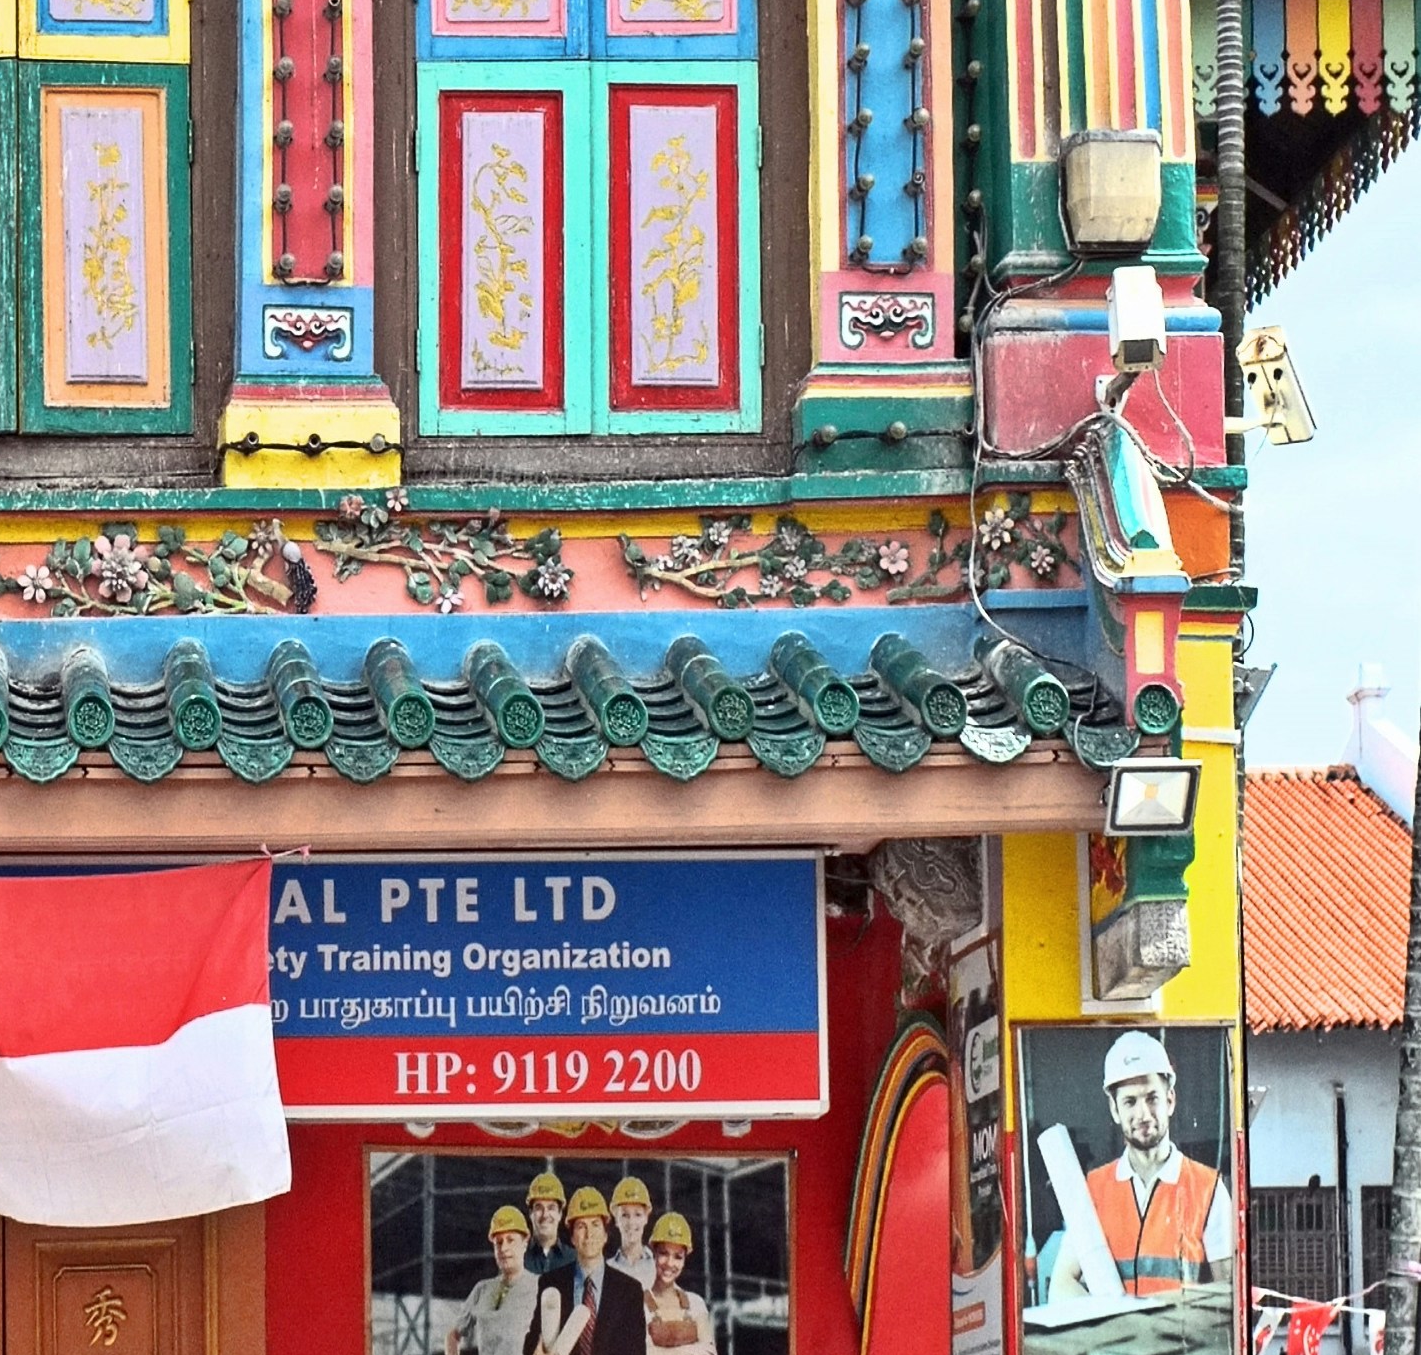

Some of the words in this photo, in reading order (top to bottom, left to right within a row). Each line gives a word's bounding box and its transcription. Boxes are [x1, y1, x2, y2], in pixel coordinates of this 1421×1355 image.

[274, 879, 346, 923] AL
[381, 878, 479, 923] PTE
[515, 876, 616, 921] LTD
[317, 944, 451, 978] Training
[463, 941, 671, 978] Organization
[396, 1053, 476, 1093] HP:
[493, 1051, 588, 1093] 9119
[604, 1050, 701, 1092] 2200
